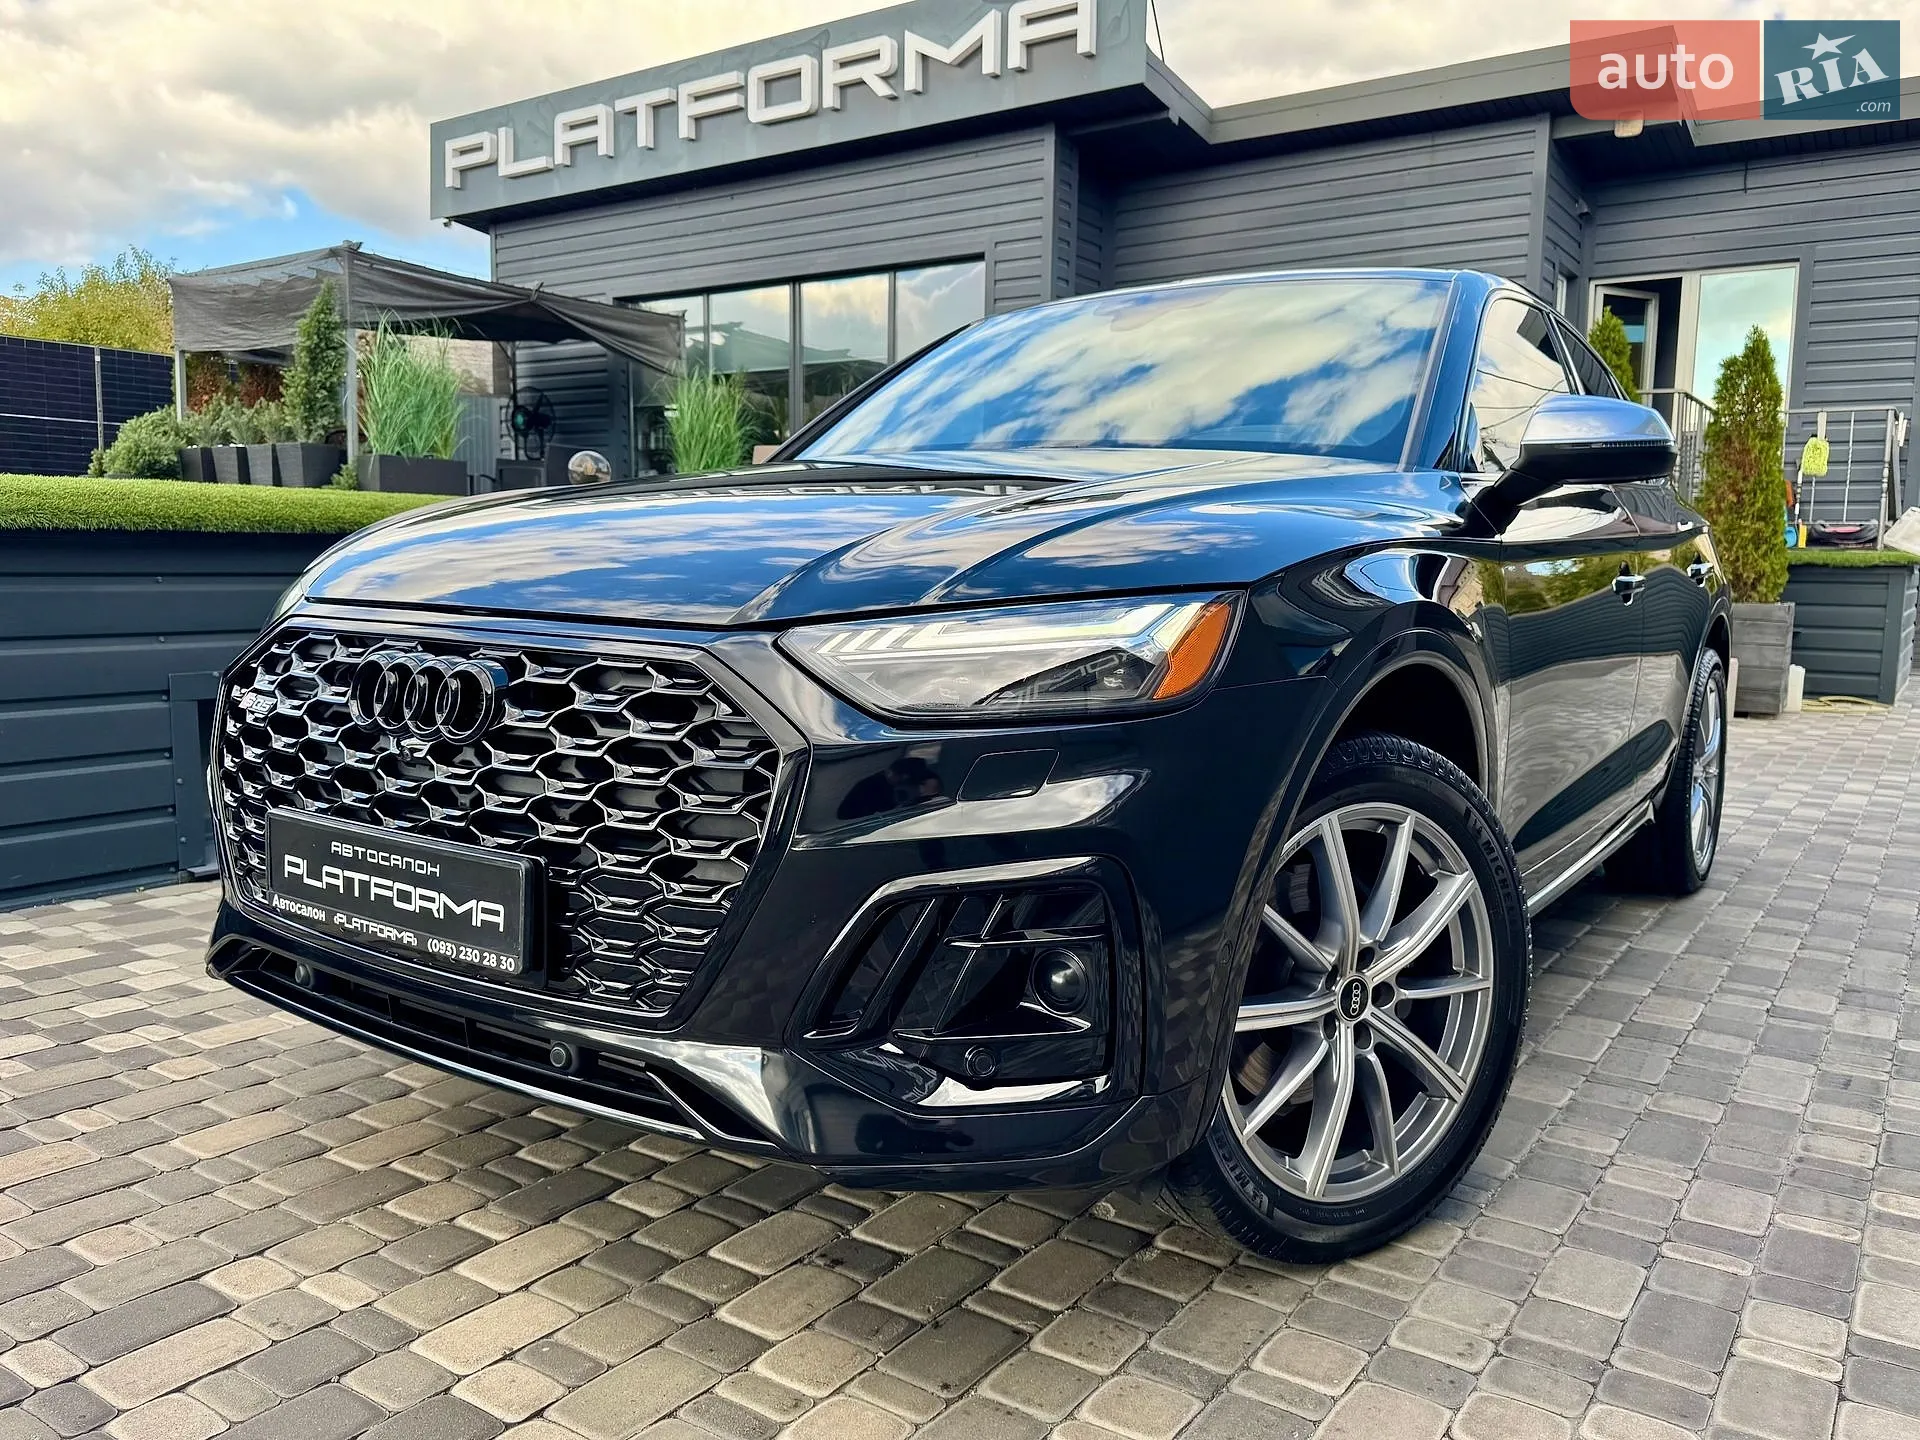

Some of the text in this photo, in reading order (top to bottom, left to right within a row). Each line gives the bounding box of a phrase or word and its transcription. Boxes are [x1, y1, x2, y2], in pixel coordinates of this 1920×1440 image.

[444, 0, 1097, 189] PLATFORMA
[284, 854, 504, 932] PLATFORMA
[331, 841, 440, 877] АВТОСАЛОН
[272, 893, 326, 921] Автосалон
[428, 938, 457, 959] (093)
[458, 946, 480, 963] 230
[482, 952, 497, 967] 28
[499, 956, 515, 972] 30
